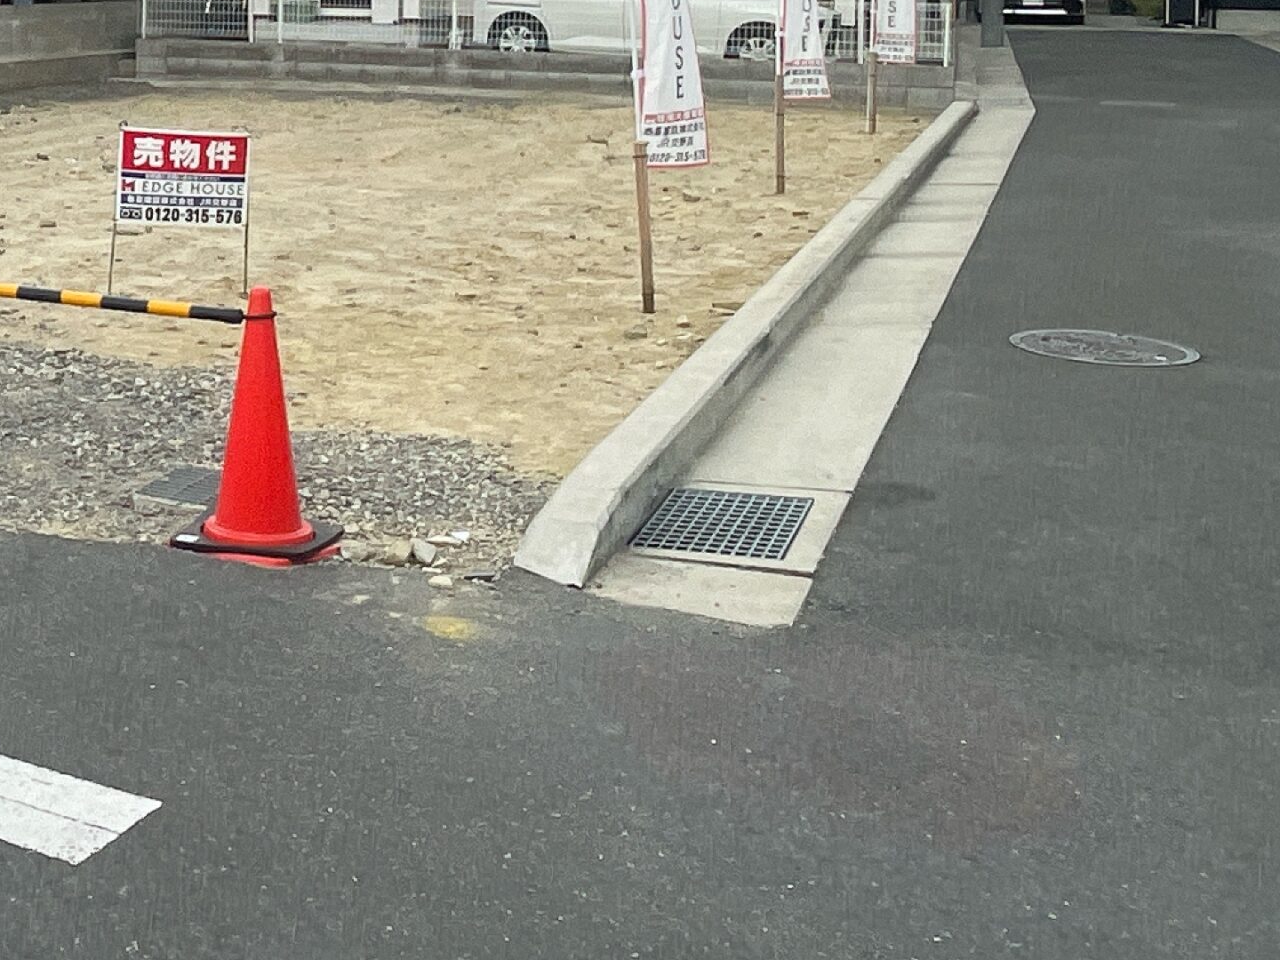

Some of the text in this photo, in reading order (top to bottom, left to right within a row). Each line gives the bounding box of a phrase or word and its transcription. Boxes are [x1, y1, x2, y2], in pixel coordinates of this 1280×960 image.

[133, 136, 237, 171] 売物件
[142, 181, 245, 196] EDGE HOUSE
